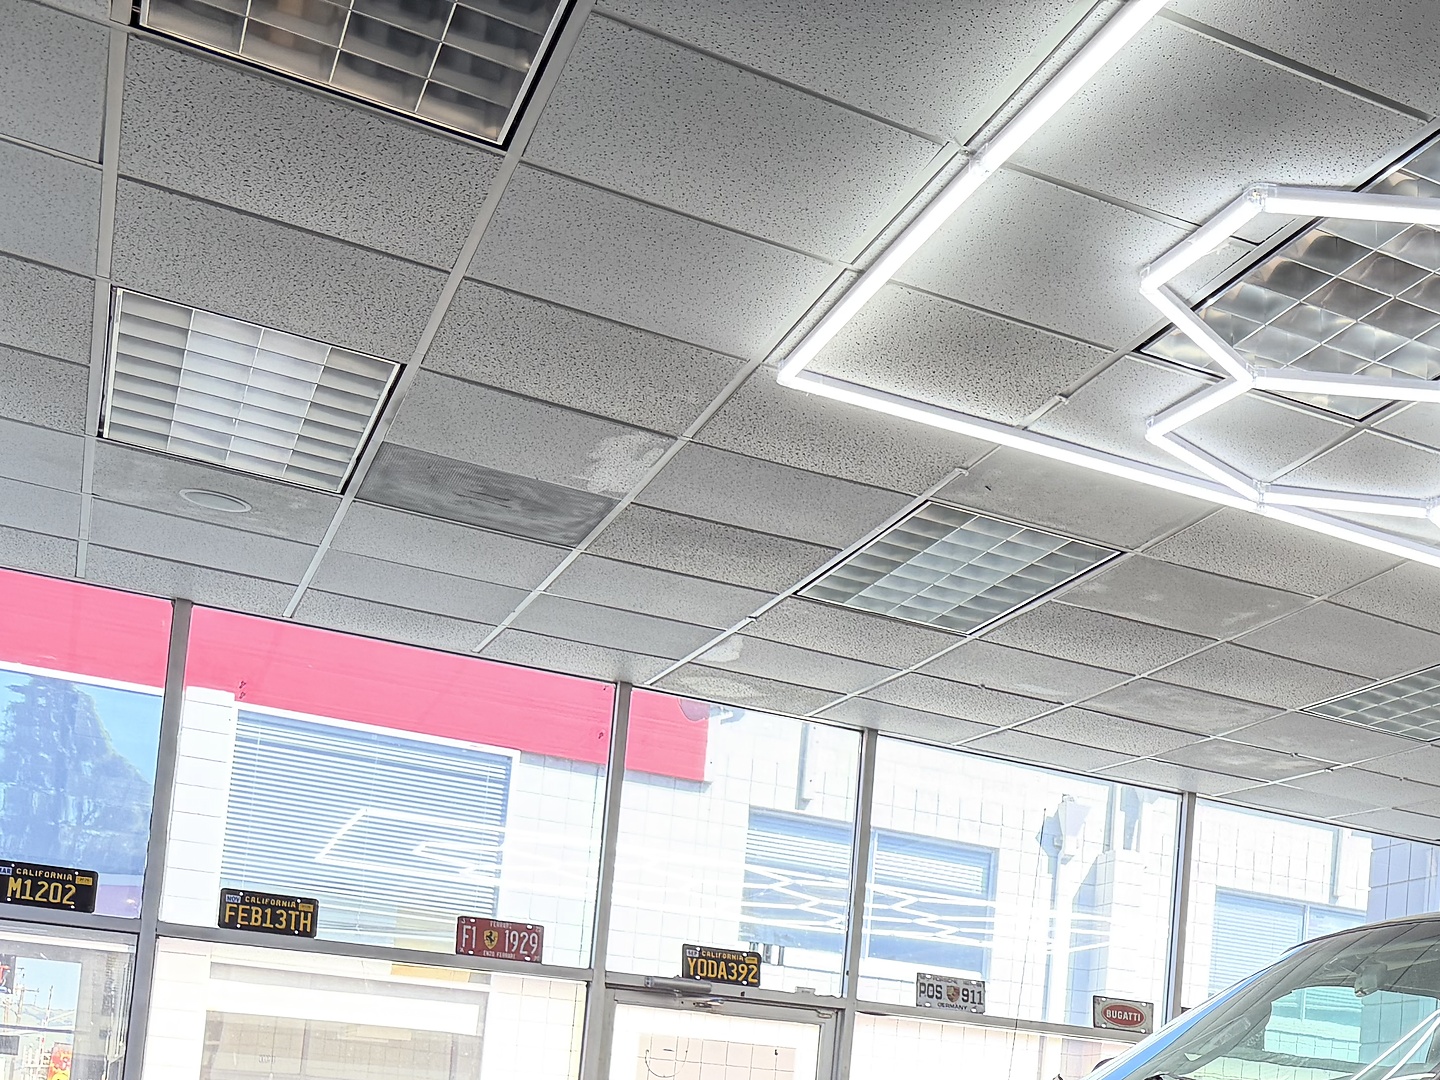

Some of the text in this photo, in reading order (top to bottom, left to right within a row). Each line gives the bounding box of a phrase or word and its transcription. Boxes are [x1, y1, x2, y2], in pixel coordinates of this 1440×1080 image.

[16, 867, 73, 881] CALIFORNIA
[7, 876, 76, 905] M1202
[244, 895, 296, 908] CALIFORNIA
[224, 903, 313, 933] FEB13TH
[462, 925, 539, 955] F1 1929
[701, 950, 744, 962] CALIFORNIA
[687, 957, 758, 983] YODA392
[919, 982, 984, 1006] POS 911
[937, 1002, 968, 1011] GERMANY
[1106, 1009, 1141, 1022] BUGATTI
